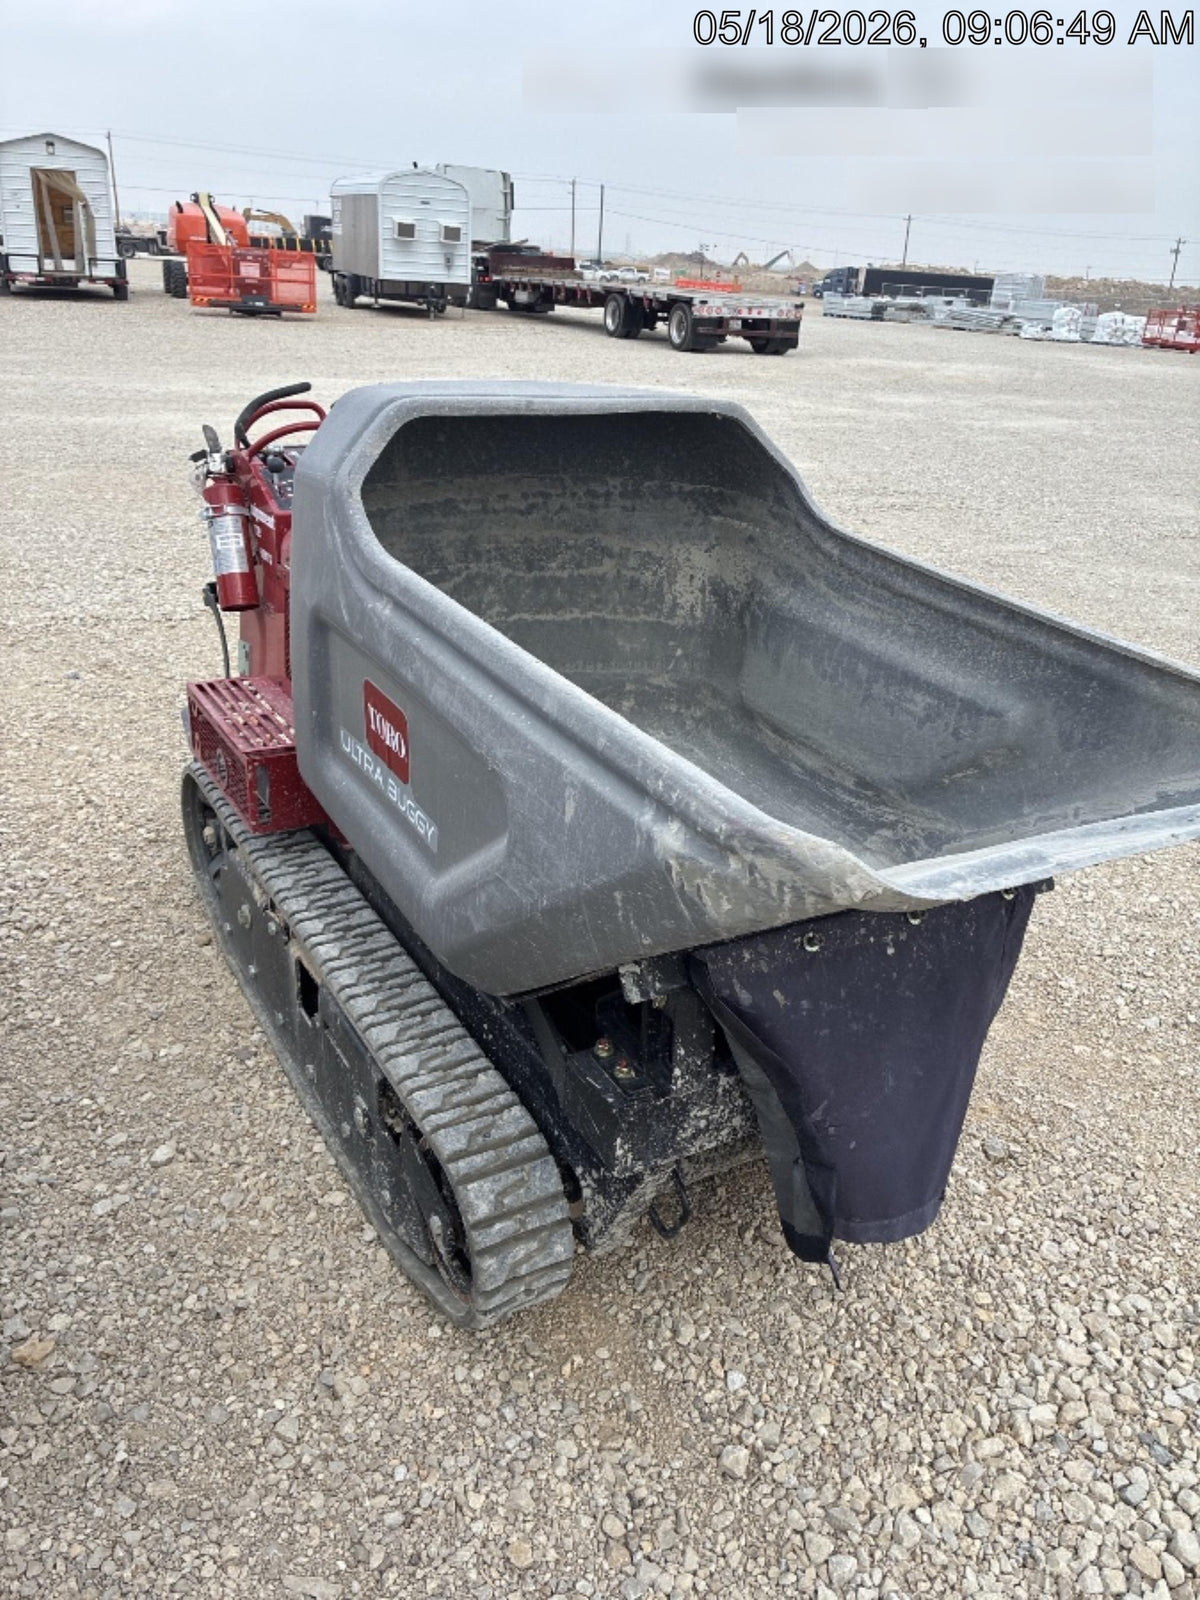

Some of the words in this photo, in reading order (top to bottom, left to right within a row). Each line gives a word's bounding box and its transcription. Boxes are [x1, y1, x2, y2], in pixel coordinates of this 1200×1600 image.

[367, 702, 406, 759] TORO
[340, 729, 384, 789] ULTRA
[387, 779, 435, 842] BUGGY
